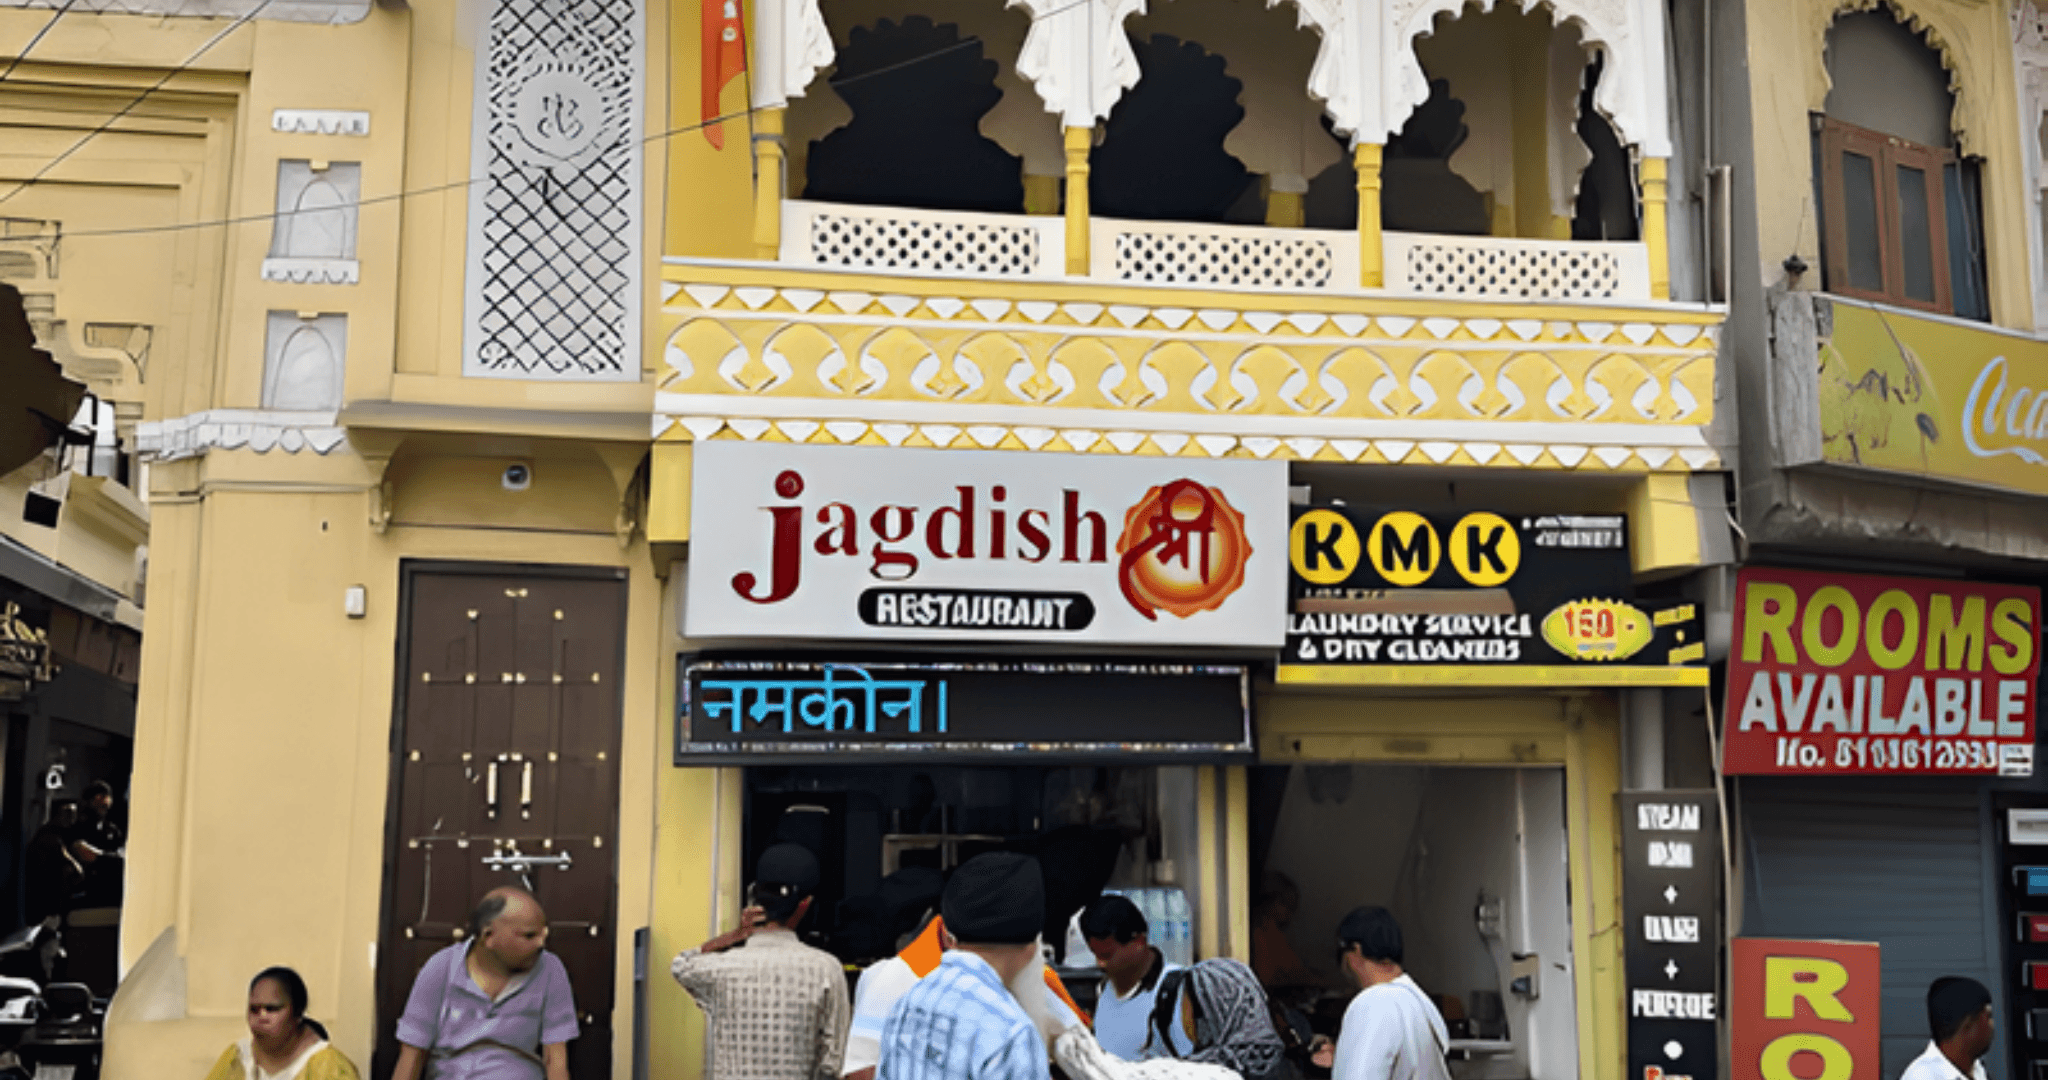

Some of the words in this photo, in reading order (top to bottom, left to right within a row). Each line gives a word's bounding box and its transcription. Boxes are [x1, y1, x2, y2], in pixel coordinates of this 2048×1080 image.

[731, 470, 1108, 605] jagdish
[1303, 522, 1509, 575] KMK
[876, 592, 1073, 629] RESTAURANT
[1741, 580, 2033, 674] ROOMS
[1738, 671, 2027, 736] AVAILABLE
